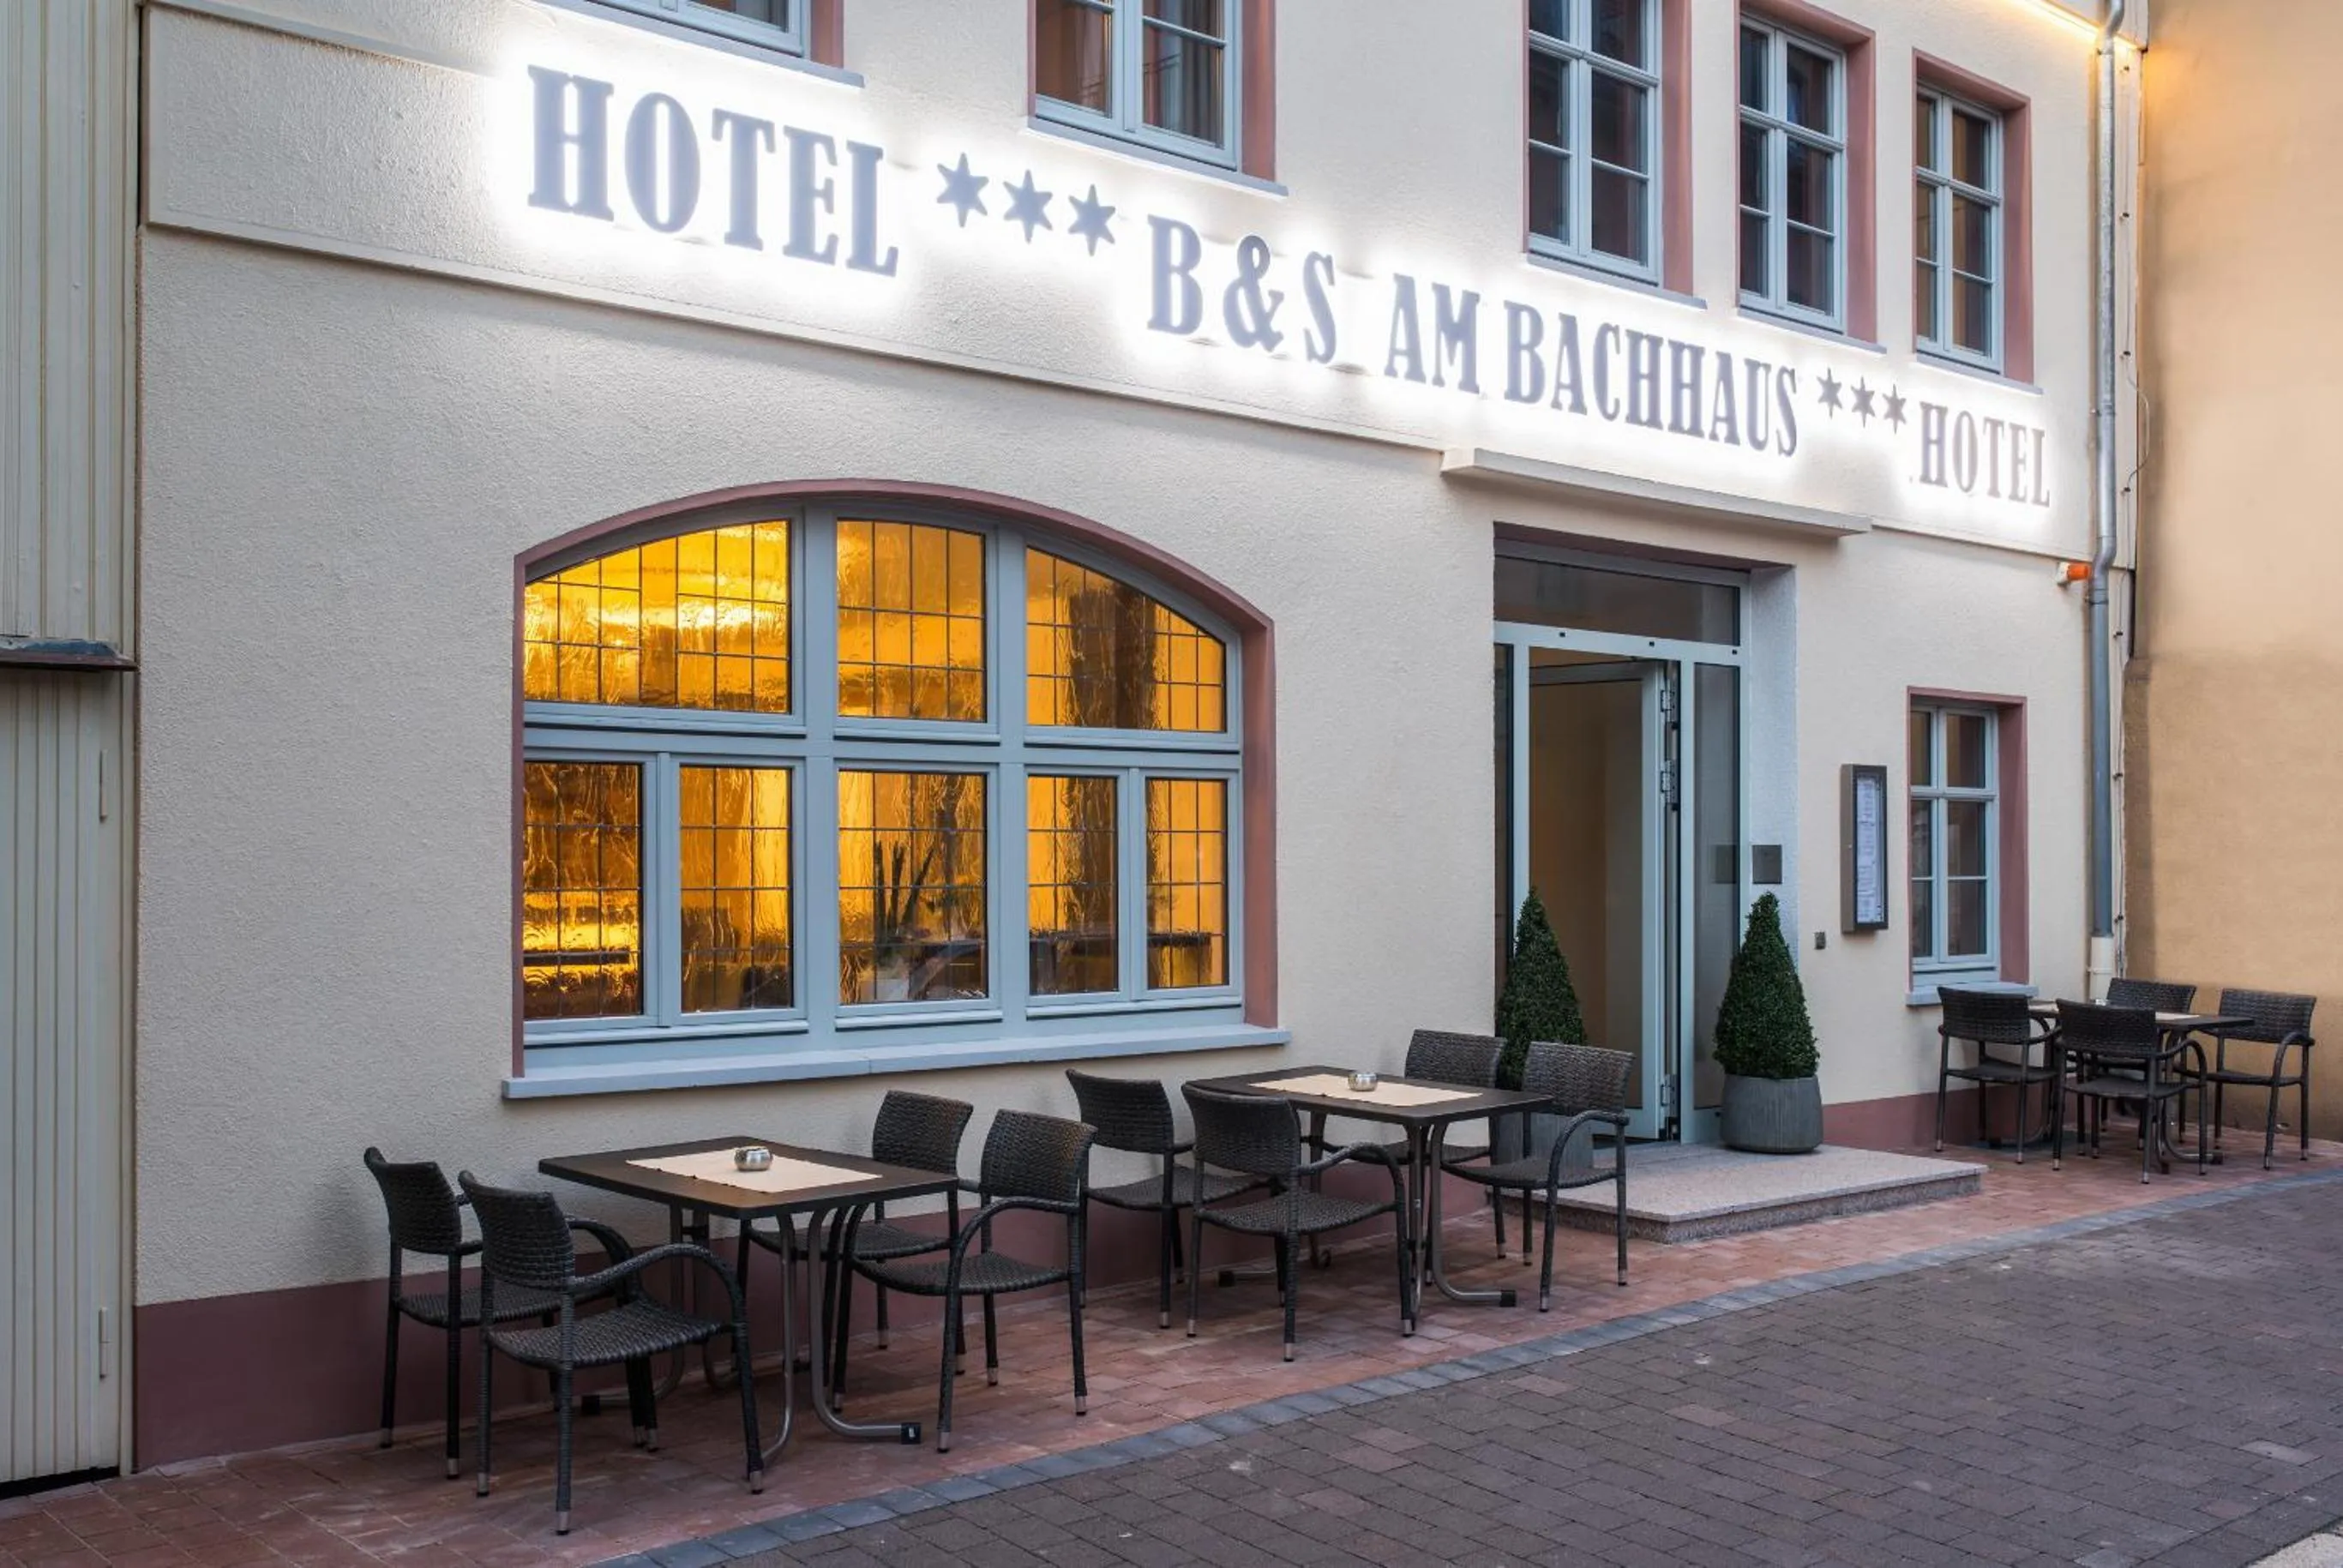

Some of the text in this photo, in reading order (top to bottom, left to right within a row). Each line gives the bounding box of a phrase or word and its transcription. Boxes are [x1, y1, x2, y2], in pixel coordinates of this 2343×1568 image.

[527, 64, 2051, 508] HOTEL B&S AM BACHHAUS HOTEL
